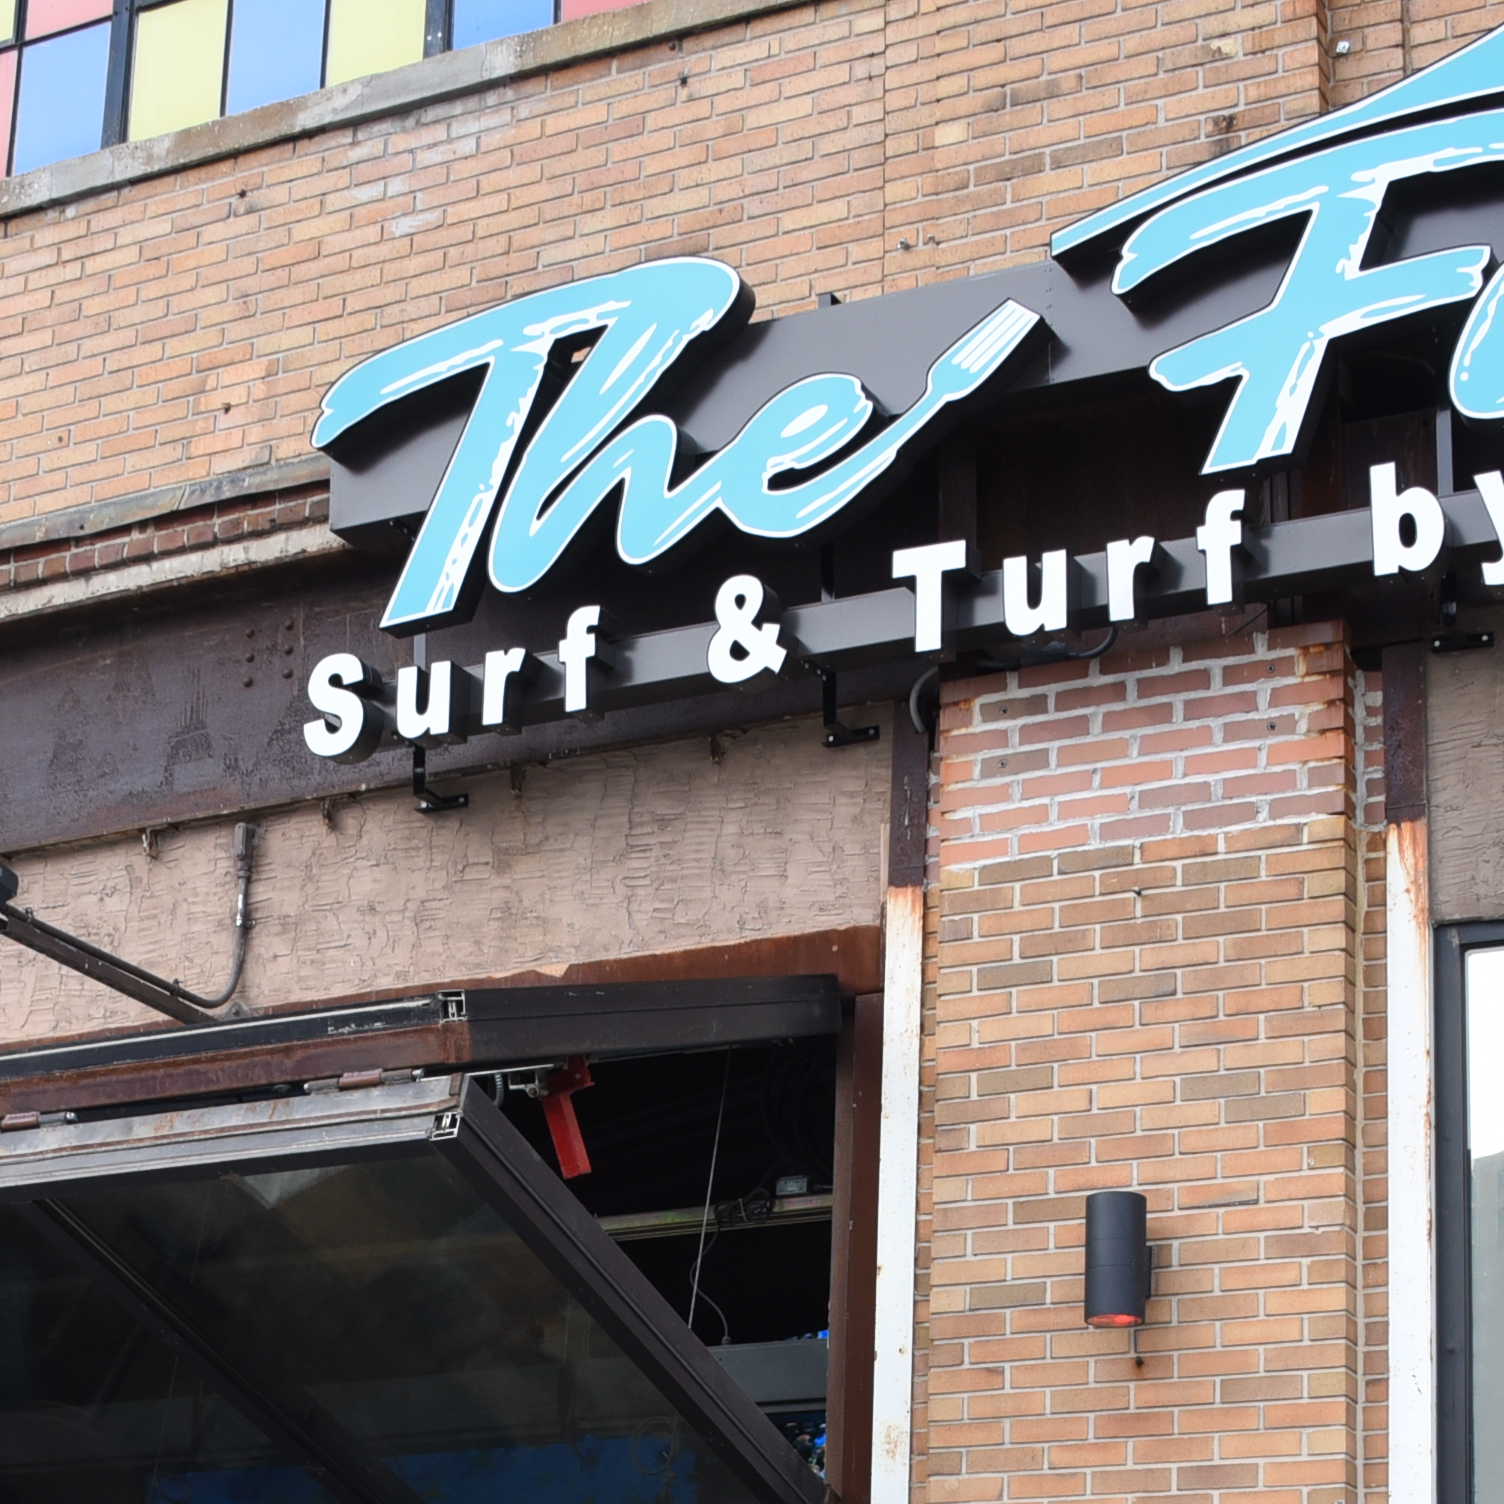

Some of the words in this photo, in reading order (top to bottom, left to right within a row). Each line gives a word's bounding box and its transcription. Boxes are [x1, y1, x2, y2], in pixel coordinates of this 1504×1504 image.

[311, 255, 1041, 628] The
[303, 605, 602, 757] Surf
[706, 574, 788, 683] &
[893, 488, 1245, 652] Turf
